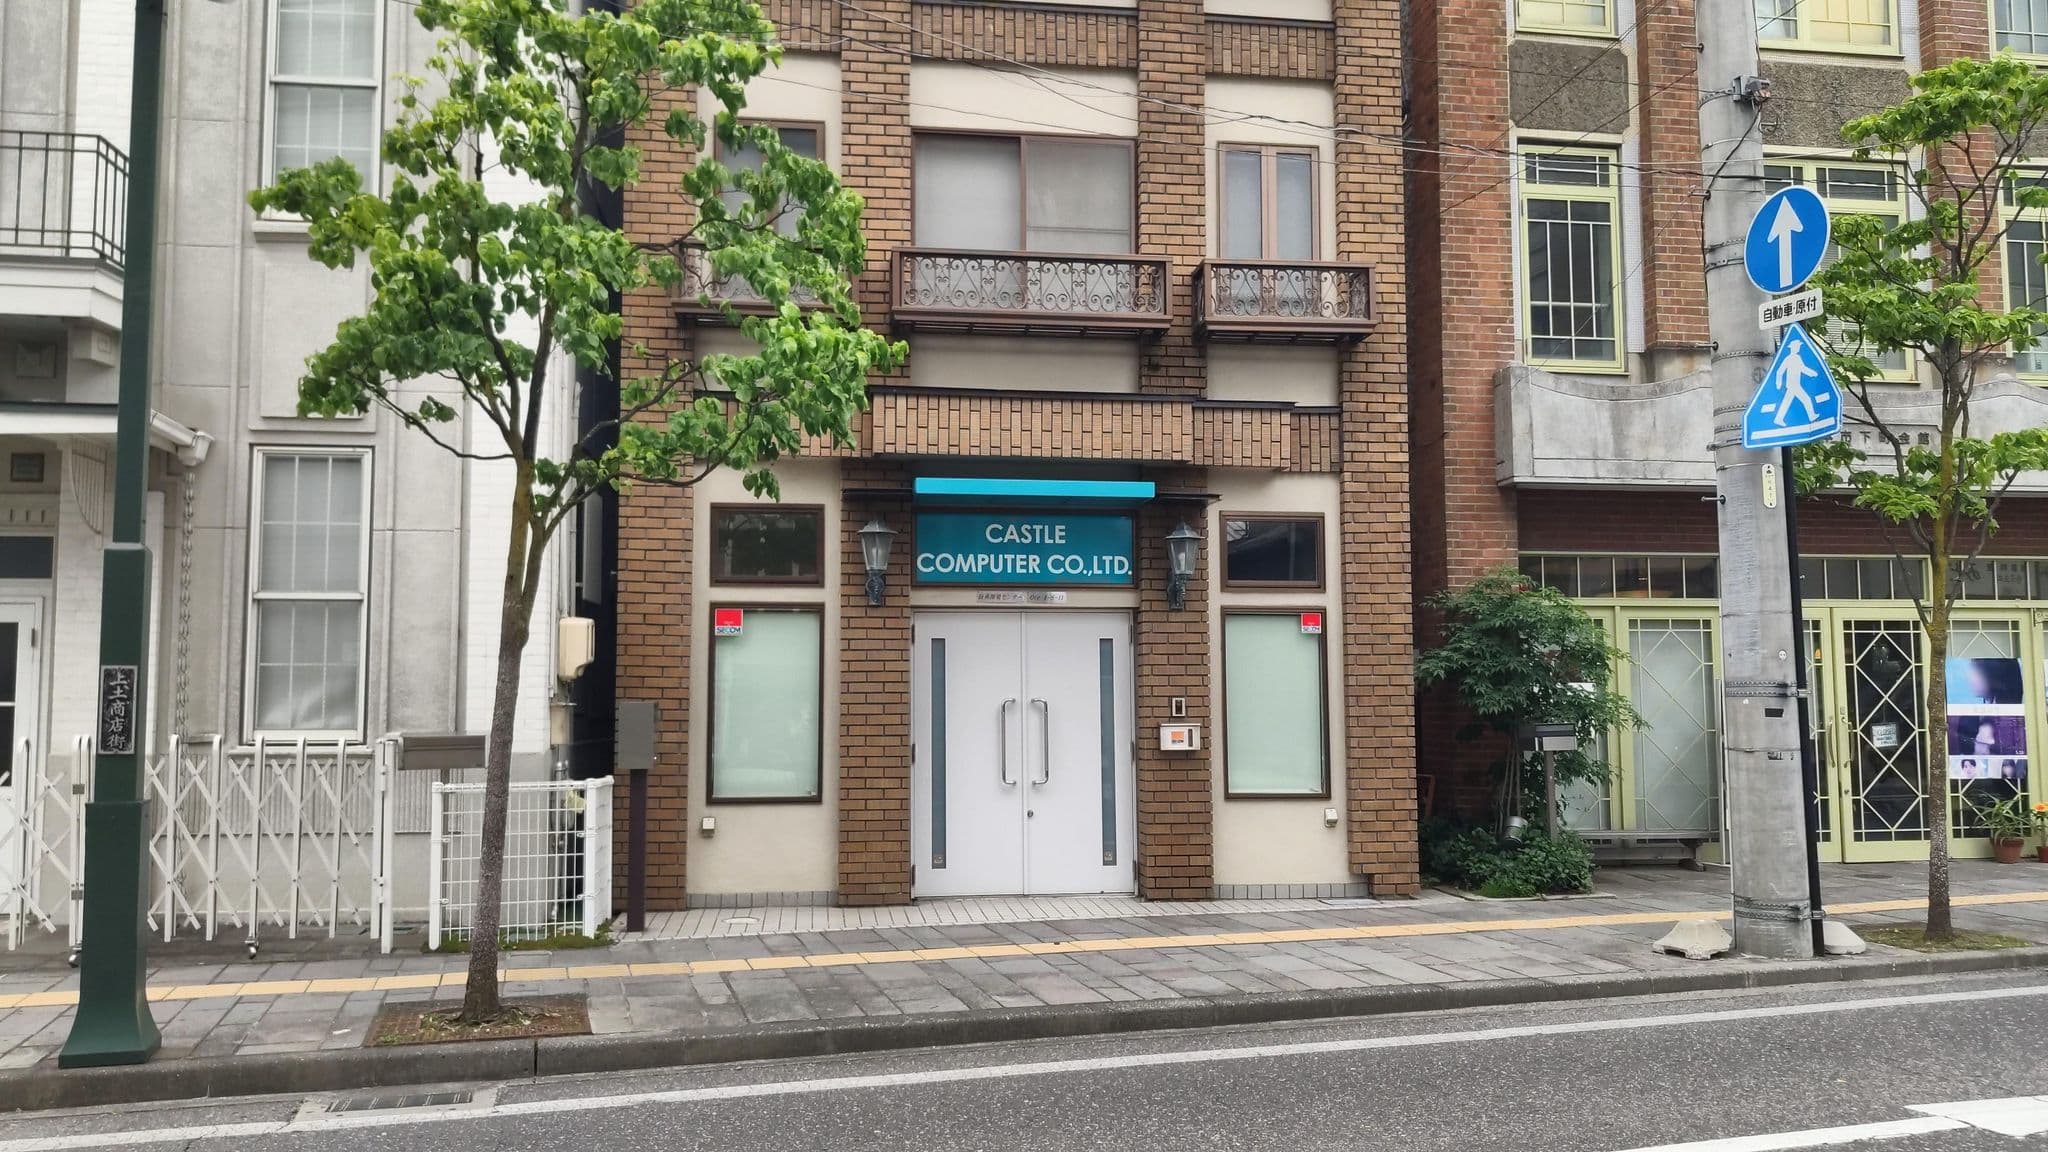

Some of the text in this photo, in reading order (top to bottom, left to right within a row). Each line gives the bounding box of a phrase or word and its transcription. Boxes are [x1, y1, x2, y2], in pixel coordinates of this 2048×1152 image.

[985, 523, 1067, 544] CASTLE
[916, 552, 1133, 576] COMPUTER CO.,LTD.
